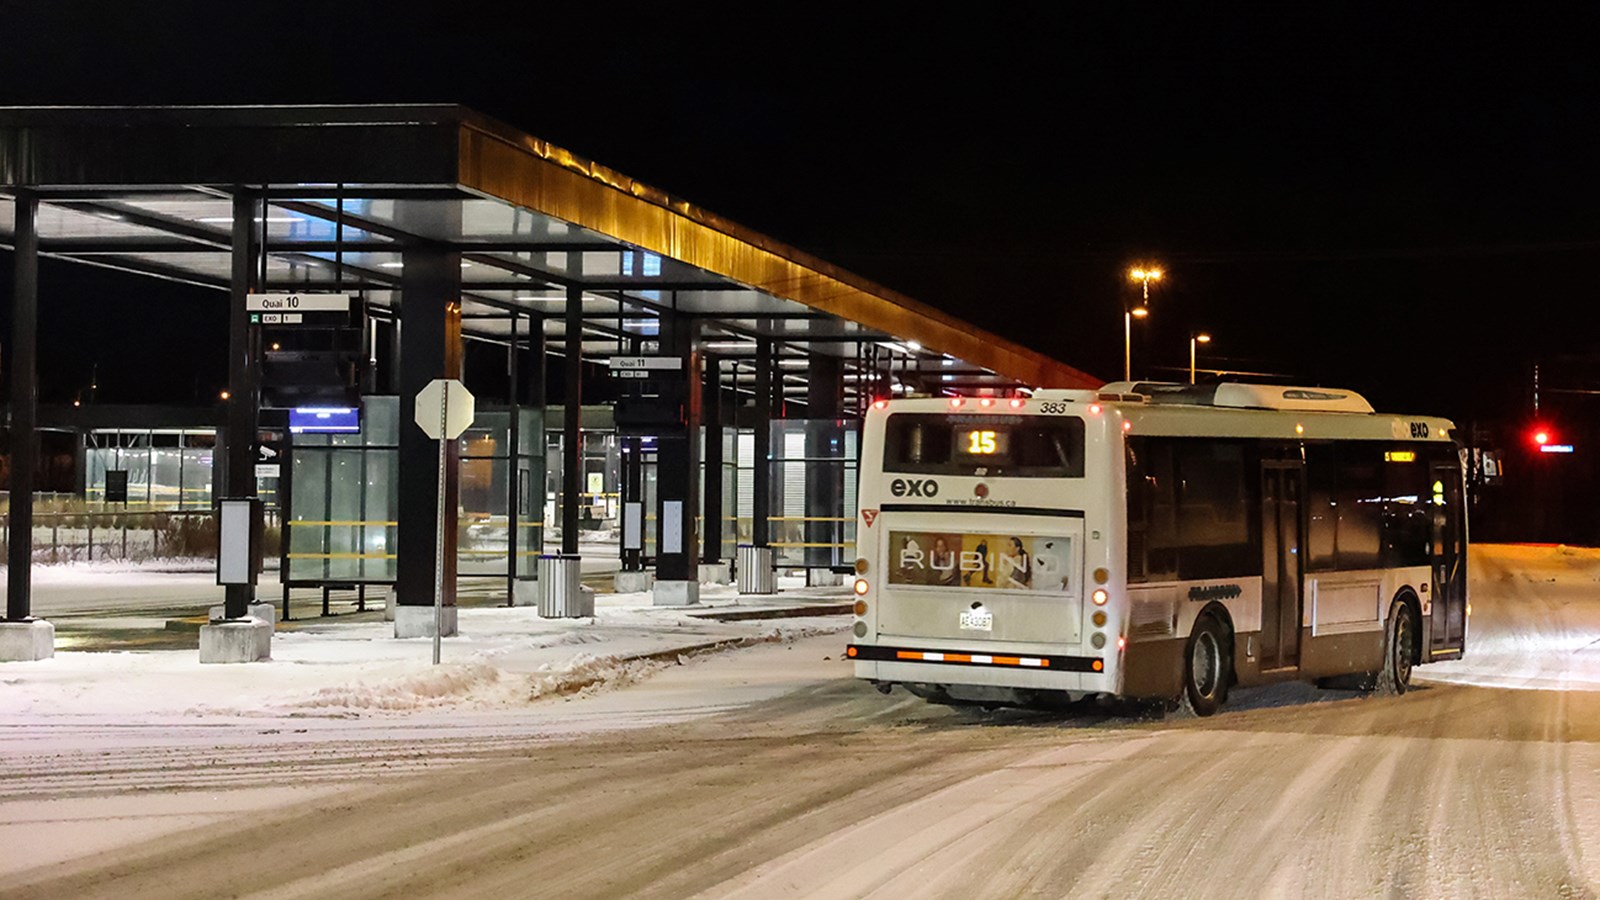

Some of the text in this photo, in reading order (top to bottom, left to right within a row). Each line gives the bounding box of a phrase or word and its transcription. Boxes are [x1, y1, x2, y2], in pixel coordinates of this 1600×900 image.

[262, 296, 299, 309] Quai 10
[637, 359, 645, 367] 11
[1040, 402, 1067, 414] 383
[1410, 421, 1430, 439] exo
[968, 430, 997, 454] 15
[891, 478, 939, 498] exo
[946, 498, 1017, 507] www.transbus.ca
